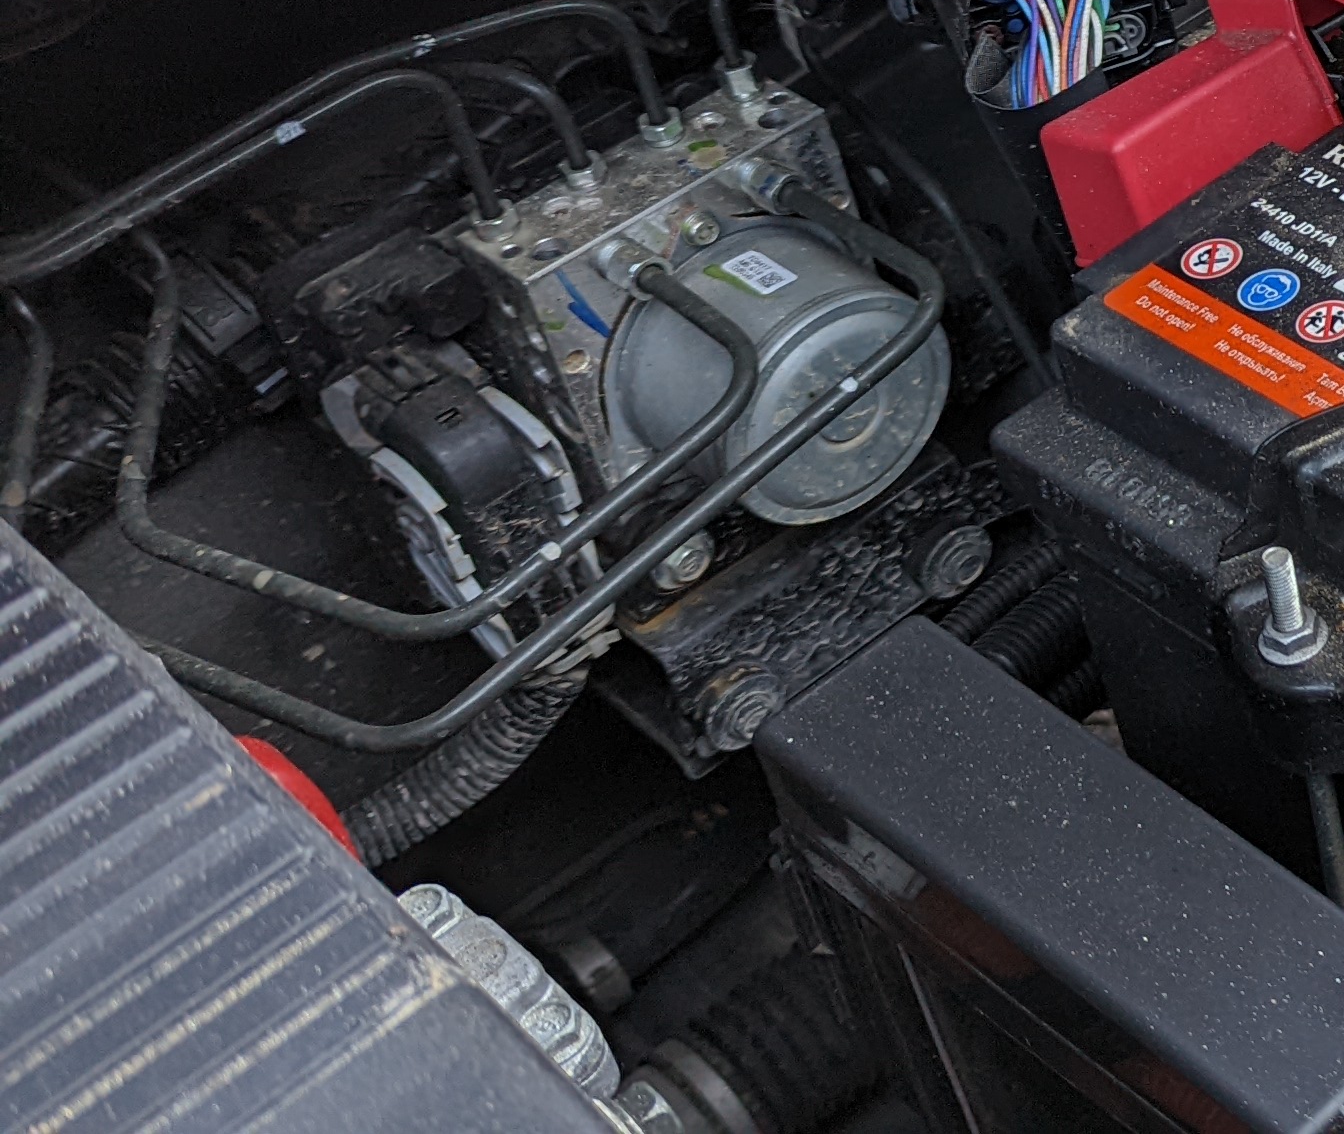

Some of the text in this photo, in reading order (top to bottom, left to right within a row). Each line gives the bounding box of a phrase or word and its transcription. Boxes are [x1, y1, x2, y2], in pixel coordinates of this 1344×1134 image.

[1299, 166, 1336, 189] 12V
[1250, 198, 1337, 247] 24410 JD11A
[1258, 230, 1337, 279] Made in Italy
[1135, 295, 1197, 332] Do not open!
[1147, 279, 1219, 323] Maintenance Free
